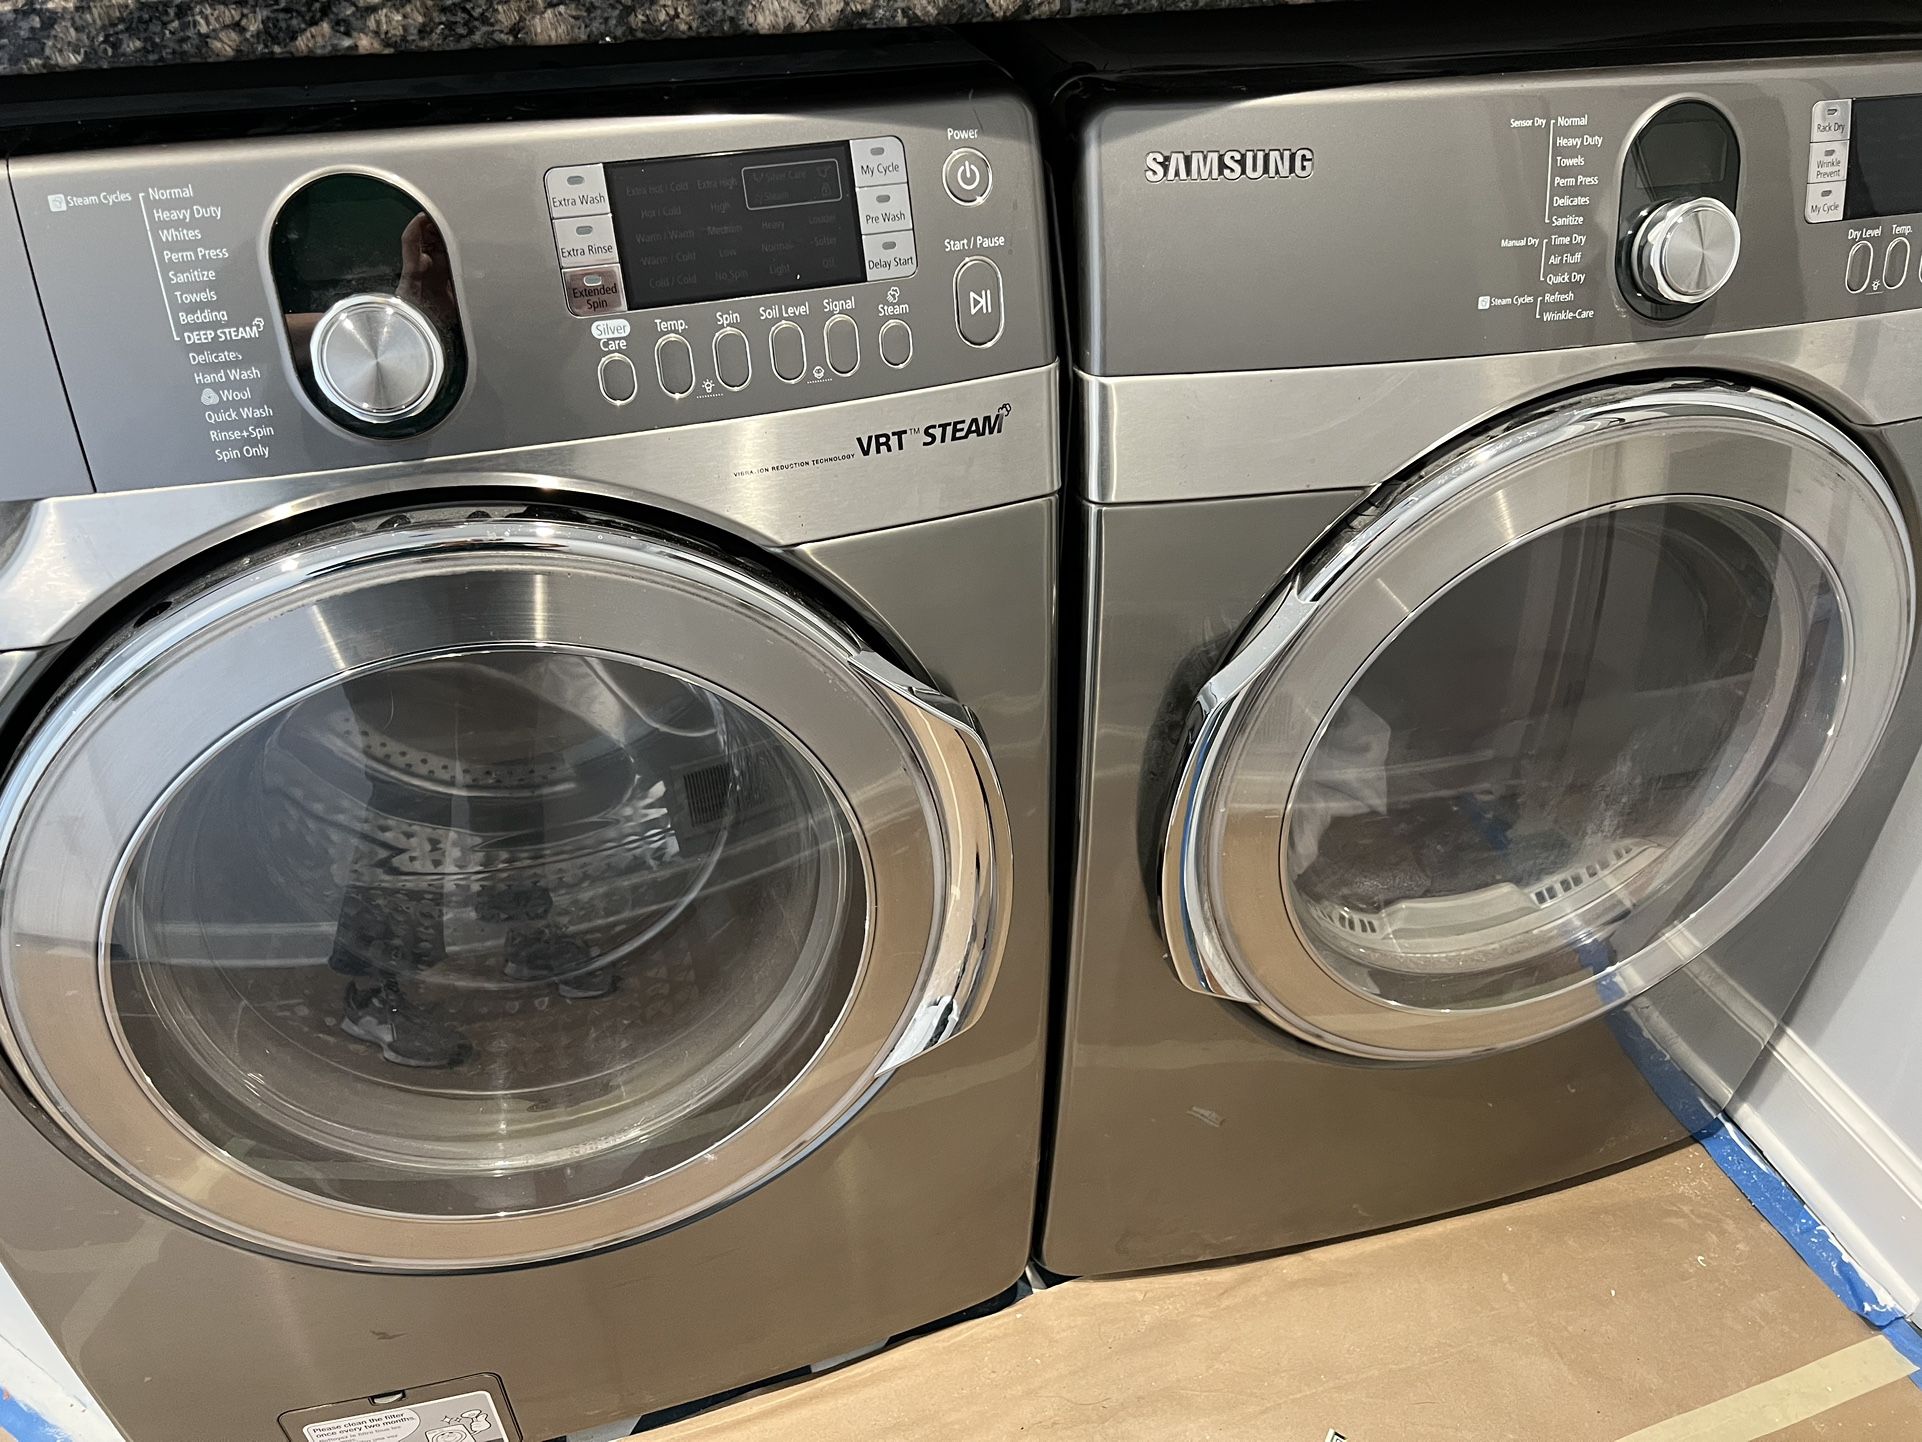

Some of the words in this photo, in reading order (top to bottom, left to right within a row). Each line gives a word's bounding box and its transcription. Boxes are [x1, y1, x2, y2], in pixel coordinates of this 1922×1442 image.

[1510, 118, 1533, 128] Sensor
[1534, 117, 1546, 128] Dry
[1557, 114, 1588, 127] Normal
[1817, 123, 1832, 133] Rack
[1833, 122, 1845, 134] Dry
[947, 128, 978, 140] Power
[1556, 136, 1582, 148] Heavy
[1583, 135, 1603, 147] Duty
[1144, 147, 1314, 184] SAMSUNG
[1557, 155, 1585, 167] Towels
[1817, 159, 1841, 169] Wrinkle
[861, 165, 875, 177] My
[877, 162, 900, 175] Cycle
[1816, 169, 1841, 179] Prevent
[1554, 176, 1575, 187] Perm
[1577, 175, 1599, 186] Press
[67, 194, 99, 208] Steam
[100, 190, 132, 206] Cycles
[149, 184, 193, 200] Normal
[552, 196, 577, 209] Extra
[578, 193, 605, 206] Wash
[1553, 195, 1590, 207] Delicates
[1811, 204, 1822, 215] My
[1822, 202, 1840, 214] Cycle
[153, 207, 191, 223] Heavy
[193, 204, 222, 221] Duty
[865, 213, 880, 225] Pre
[881, 211, 906, 223] Wash
[1552, 215, 1584, 226] Sanitize
[159, 228, 201, 242] Whites
[1848, 228, 1861, 241] Dry
[1863, 226, 1882, 238] Level
[1892, 224, 1913, 236] Temp.
[945, 238, 968, 252] Start
[977, 234, 1005, 248] Pause
[1501, 237, 1526, 248] Manual
[1527, 236, 1540, 248] Dry
[1551, 235, 1570, 246] Time
[1572, 233, 1587, 246] Dry
[164, 250, 195, 264] Perm
[198, 246, 229, 260] Press
[561, 246, 586, 259] Extra
[587, 243, 613, 255] Rinse
[1548, 254, 1561, 265] Air
[1563, 252, 1582, 264] Fluff
[868, 259, 891, 272] Delay
[892, 255, 914, 268] Start
[169, 268, 216, 284] Sanitize
[1546, 272, 1570, 285] Quick
[1571, 272, 1586, 284] Dry
[174, 289, 217, 304] Towels
[572, 283, 618, 299] Extended
[1544, 291, 1574, 303] Refresh
[586, 299, 608, 312] Spin
[823, 296, 855, 314] Signal
[1490, 297, 1512, 306] Steam
[1513, 295, 1534, 307] Cycles
[179, 309, 228, 325] Bedding
[760, 304, 780, 320] Soil
[783, 302, 810, 317] Level
[878, 302, 910, 317] Steam
[1543, 309, 1595, 322] Wrinkle-Care
[654, 318, 689, 333] Temp.
[716, 311, 741, 326] Spin
[184, 330, 215, 345] DEEP
[217, 326, 259, 342] STEAM
[595, 322, 627, 337] Silver
[600, 337, 627, 351] Care
[189, 350, 243, 365] Delicates
[194, 369, 226, 385] Hand
[227, 366, 261, 381] Wash
[220, 387, 252, 402] Wool
[205, 408, 239, 424] Quick
[240, 404, 274, 419] Wash
[210, 424, 275, 442] Rinse+Spin
[733, 467, 770, 478] VIBRAION
[771, 460, 810, 472] REDUCTION
[811, 453, 856, 466] TECHNOLOGY
[922, 412, 1004, 447] STEAM
[215, 447, 241, 463] Spin
[243, 444, 270, 459] Only
[368, 1416, 383, 1424] the
[316, 1431, 337, 1439] once
[339, 1426, 363, 1435] every
[364, 1422, 381, 1430] two
